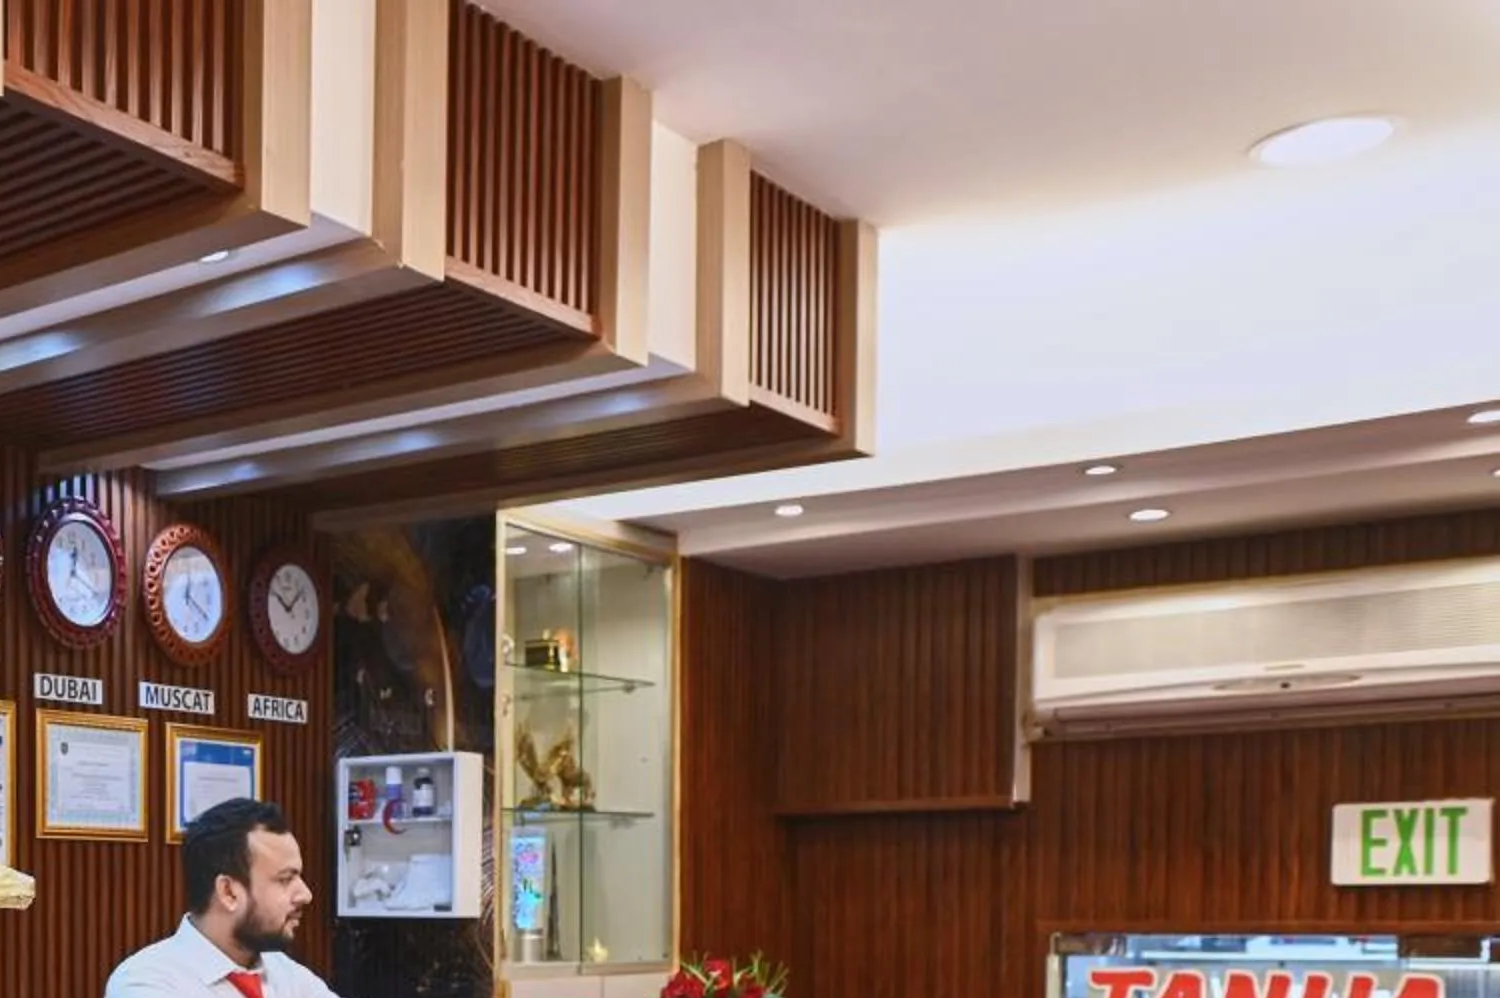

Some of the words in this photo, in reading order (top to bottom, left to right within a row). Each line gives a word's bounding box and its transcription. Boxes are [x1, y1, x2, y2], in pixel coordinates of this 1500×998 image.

[38, 675, 97, 702] DUBAI
[144, 685, 212, 712] MUSCAT
[251, 697, 305, 721] AFRICA
[1360, 806, 1468, 877] EXIT
